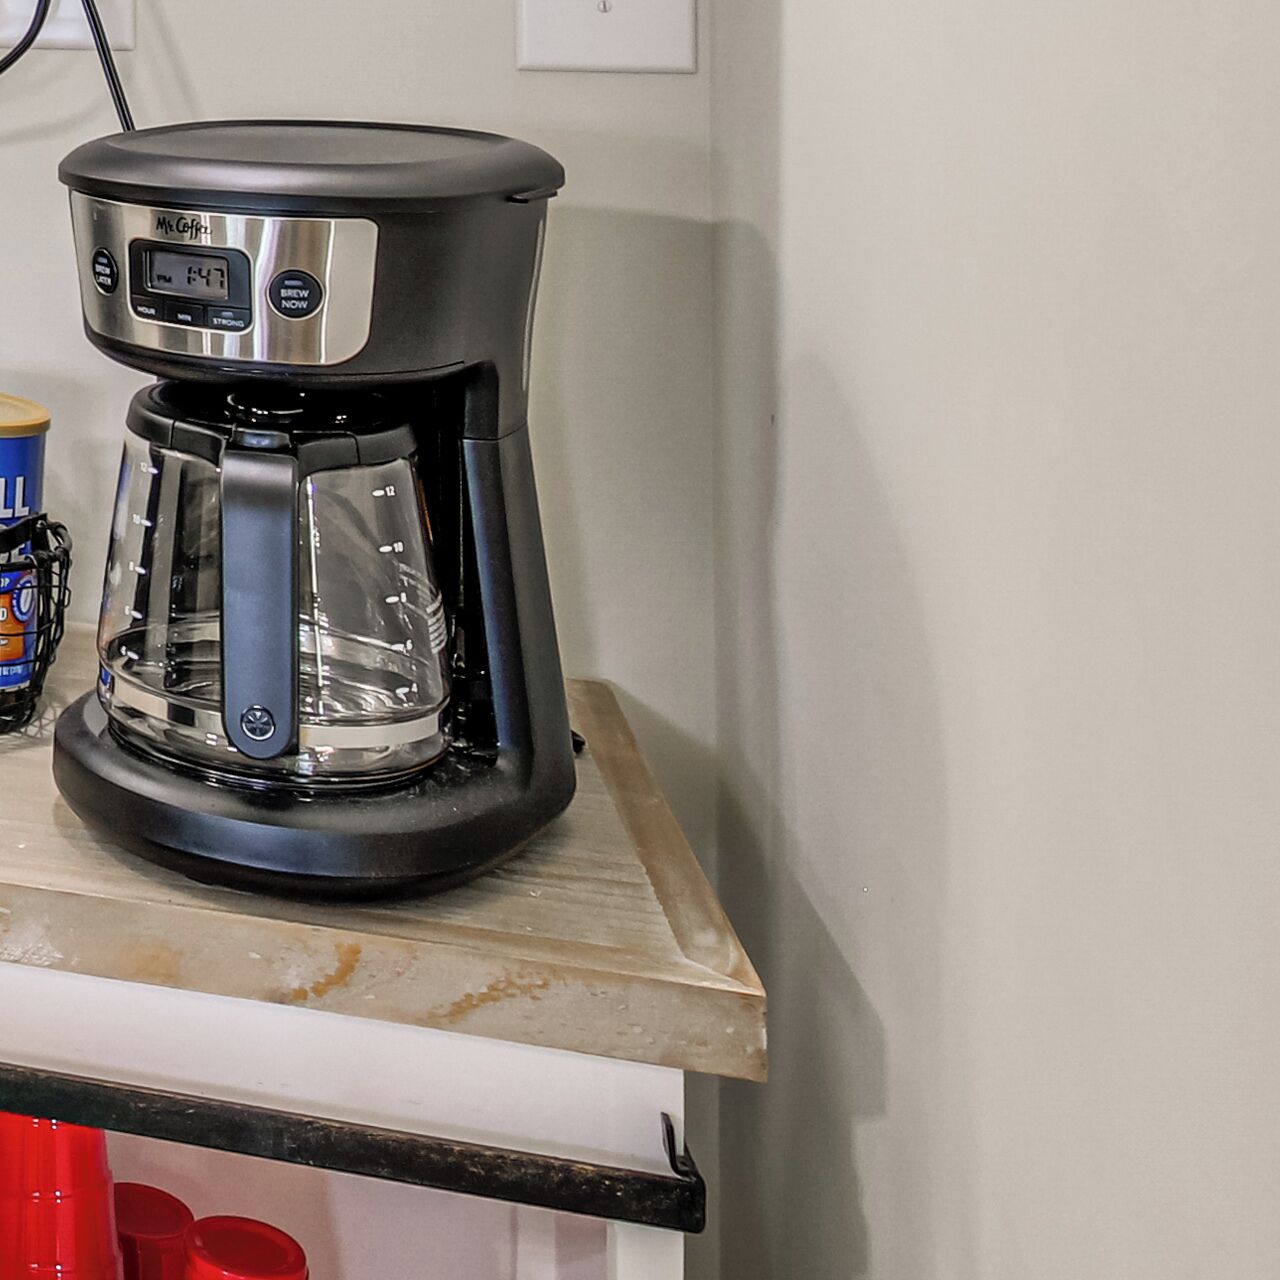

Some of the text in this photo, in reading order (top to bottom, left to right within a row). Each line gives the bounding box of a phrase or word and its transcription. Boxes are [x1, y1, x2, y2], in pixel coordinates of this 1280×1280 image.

[187, 266, 225, 289] 1:47
[280, 288, 309, 298] BREW
[281, 300, 308, 309] NOW
[212, 317, 244, 328] STRONG
[385, 485, 396, 497] 12
[393, 541, 404, 553] 10
